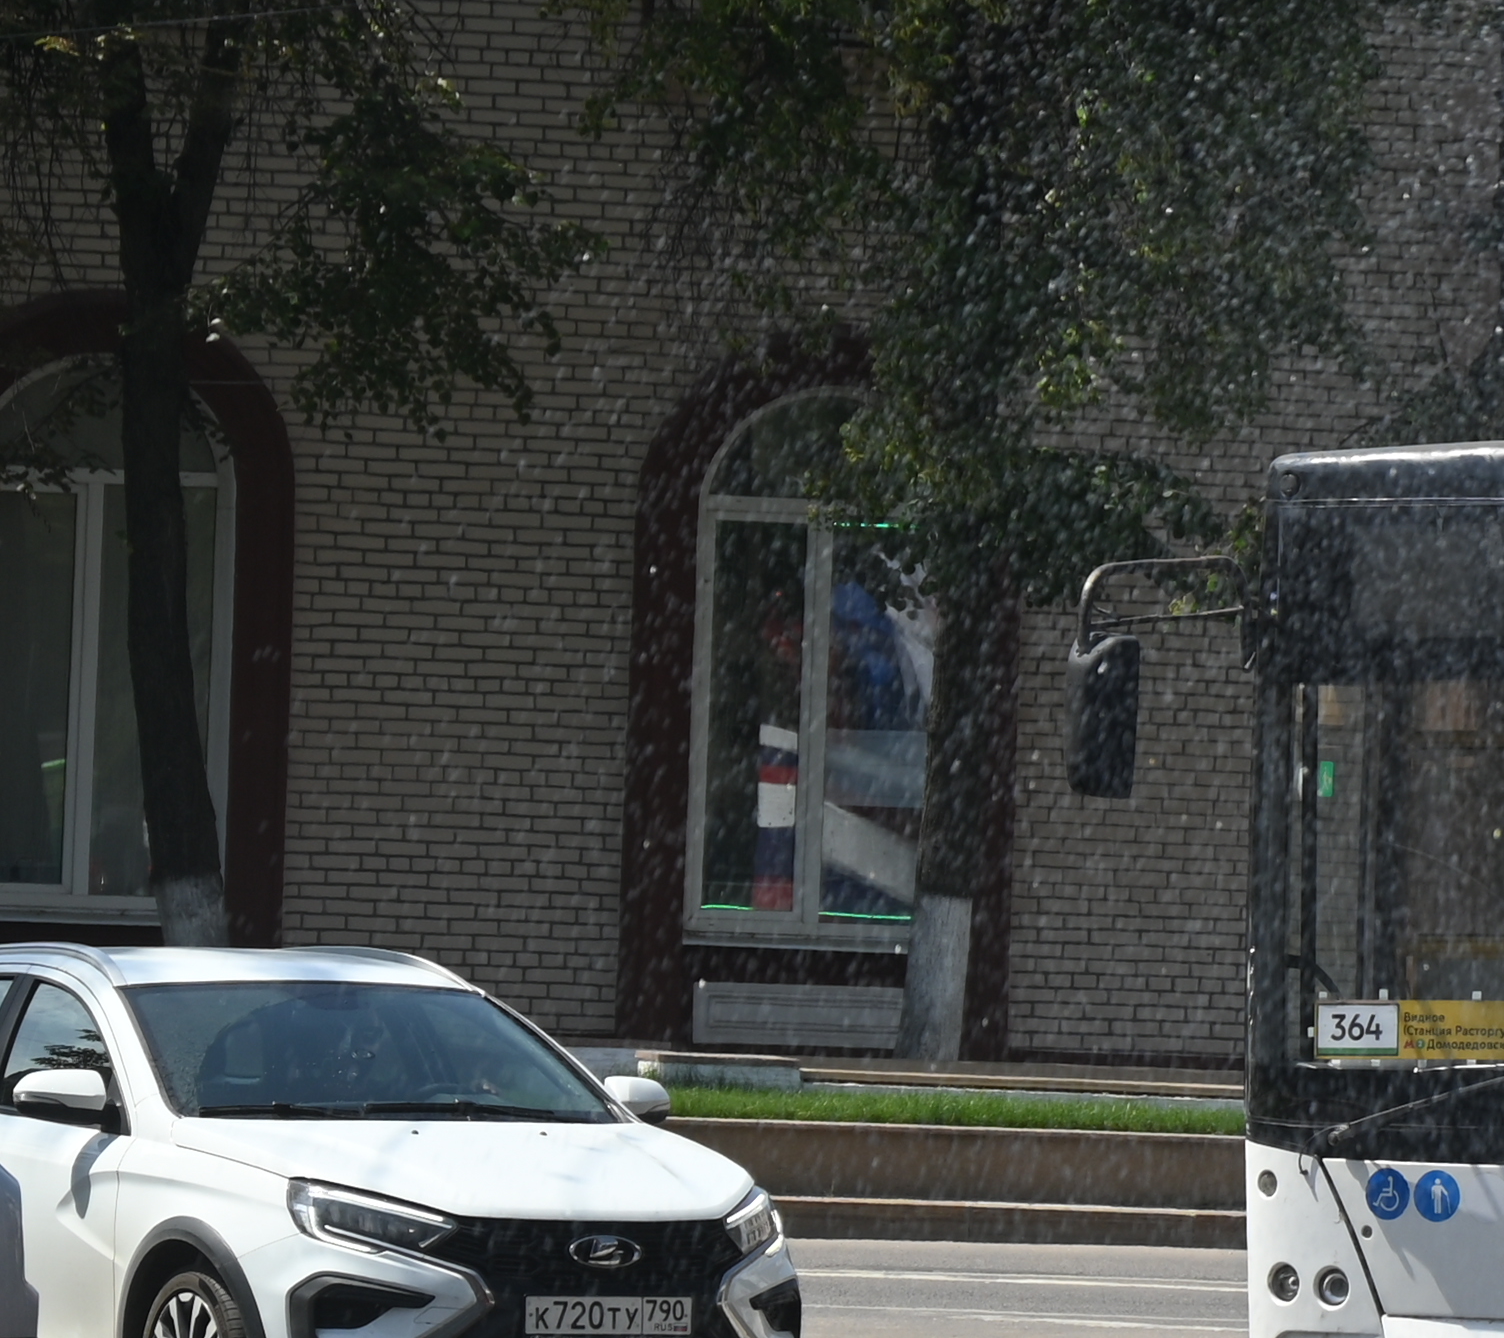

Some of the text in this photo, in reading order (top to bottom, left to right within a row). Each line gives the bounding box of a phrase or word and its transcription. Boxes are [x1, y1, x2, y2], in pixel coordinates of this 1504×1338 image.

[1330, 1013, 1382, 1041] 364
[1403, 1011, 1446, 1024] Видное
[645, 1299, 685, 1322] 790
